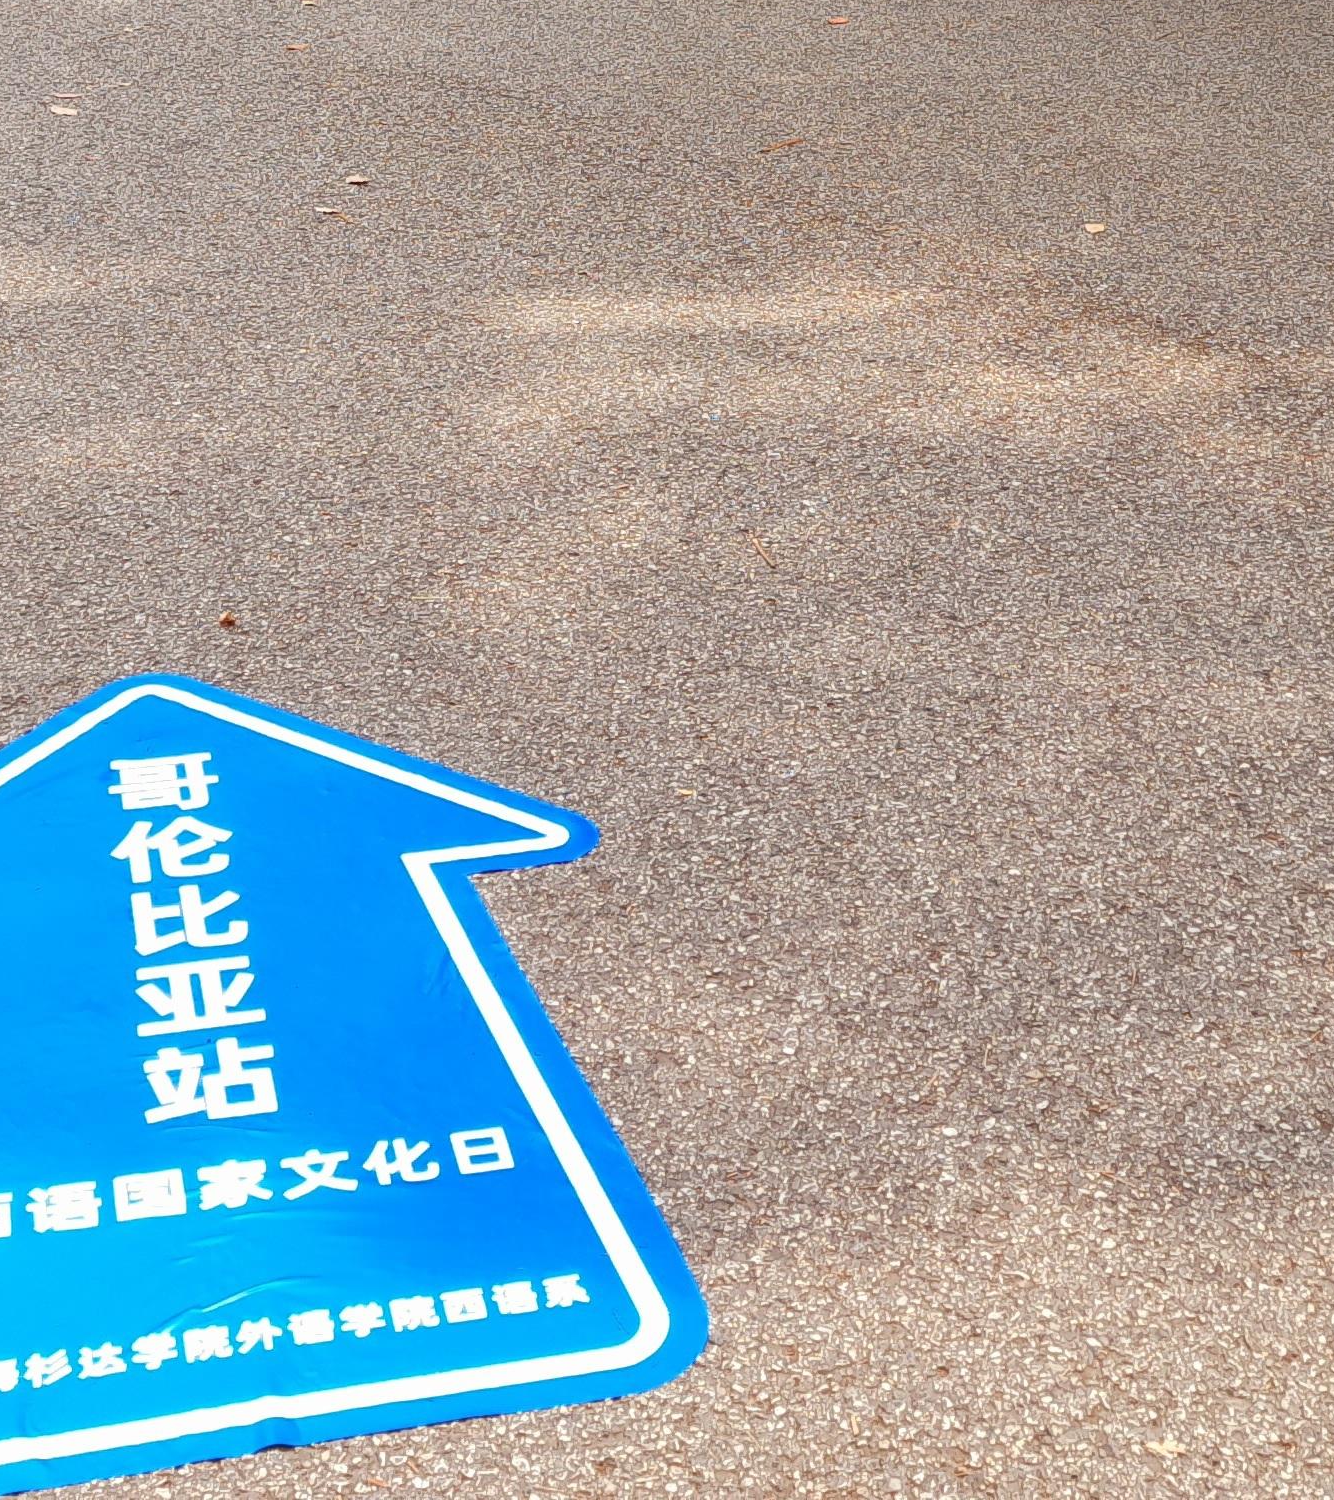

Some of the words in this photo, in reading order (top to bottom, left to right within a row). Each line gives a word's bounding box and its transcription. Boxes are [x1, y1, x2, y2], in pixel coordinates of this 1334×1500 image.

[108, 751, 279, 1125] 哥伦比亚站
